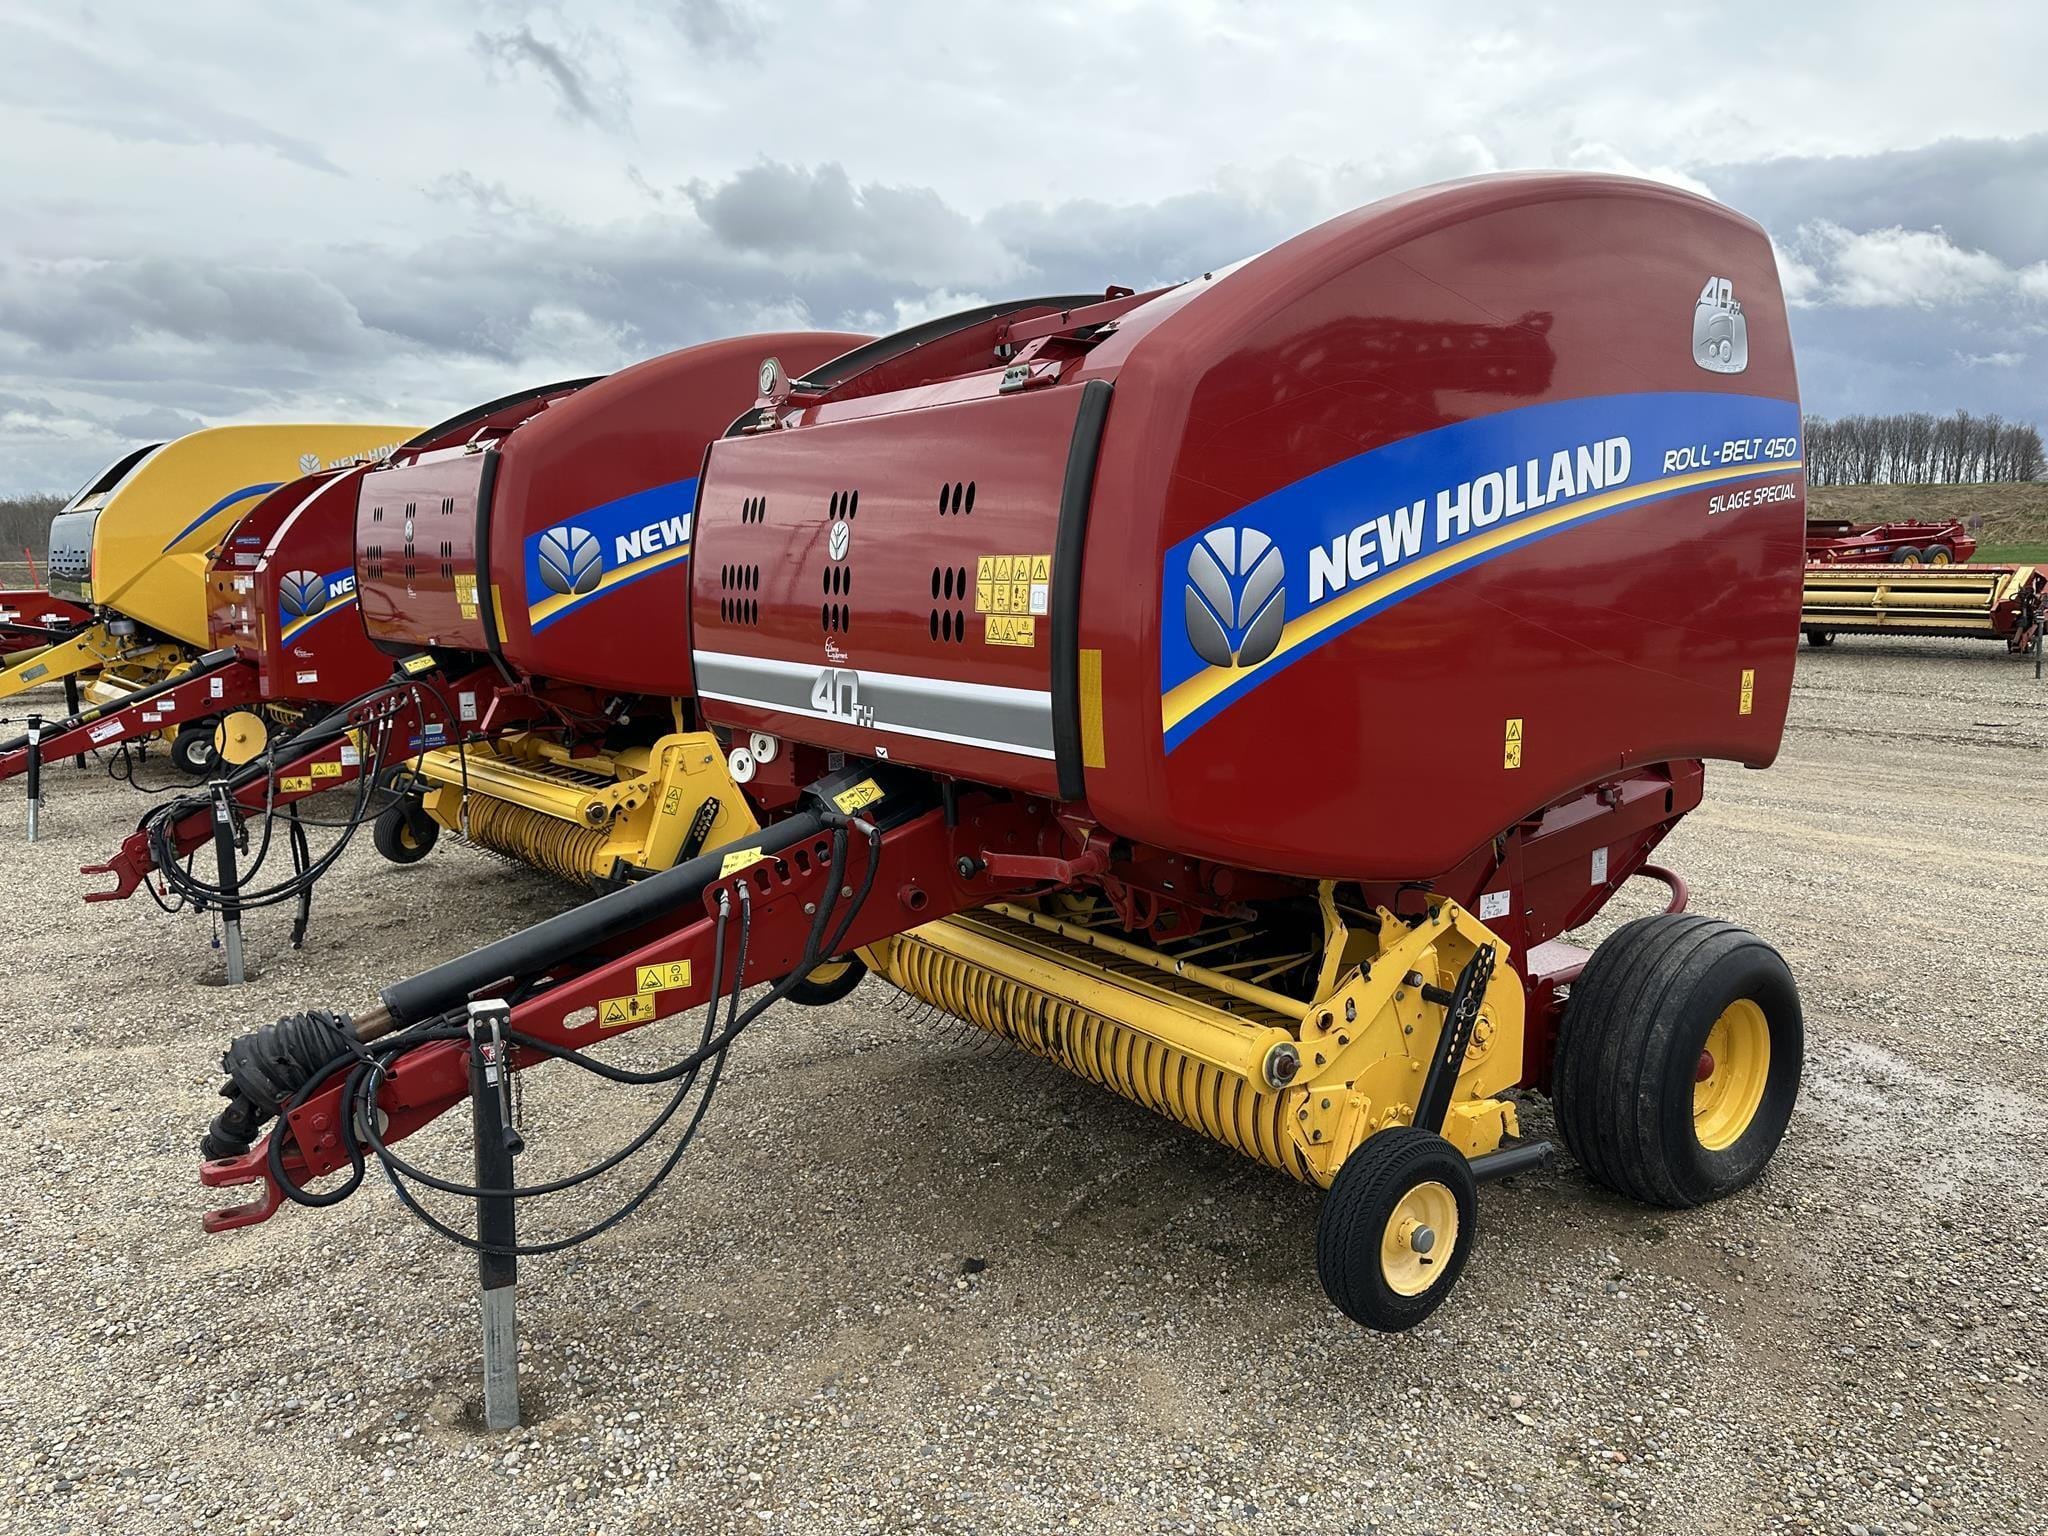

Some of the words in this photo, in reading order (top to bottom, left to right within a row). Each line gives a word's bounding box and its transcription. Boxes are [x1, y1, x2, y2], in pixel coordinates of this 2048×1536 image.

[1662, 438, 1762, 474] ROLL-BELT
[1764, 437, 1797, 459] 450
[1708, 489, 1752, 515] SILAGE
[1752, 482, 1797, 506] SPECIAL
[1309, 498, 1427, 604] NEW
[1436, 435, 1632, 544] HOLLAND
[615, 512, 692, 565] NEW
[329, 575, 356, 598] NE
